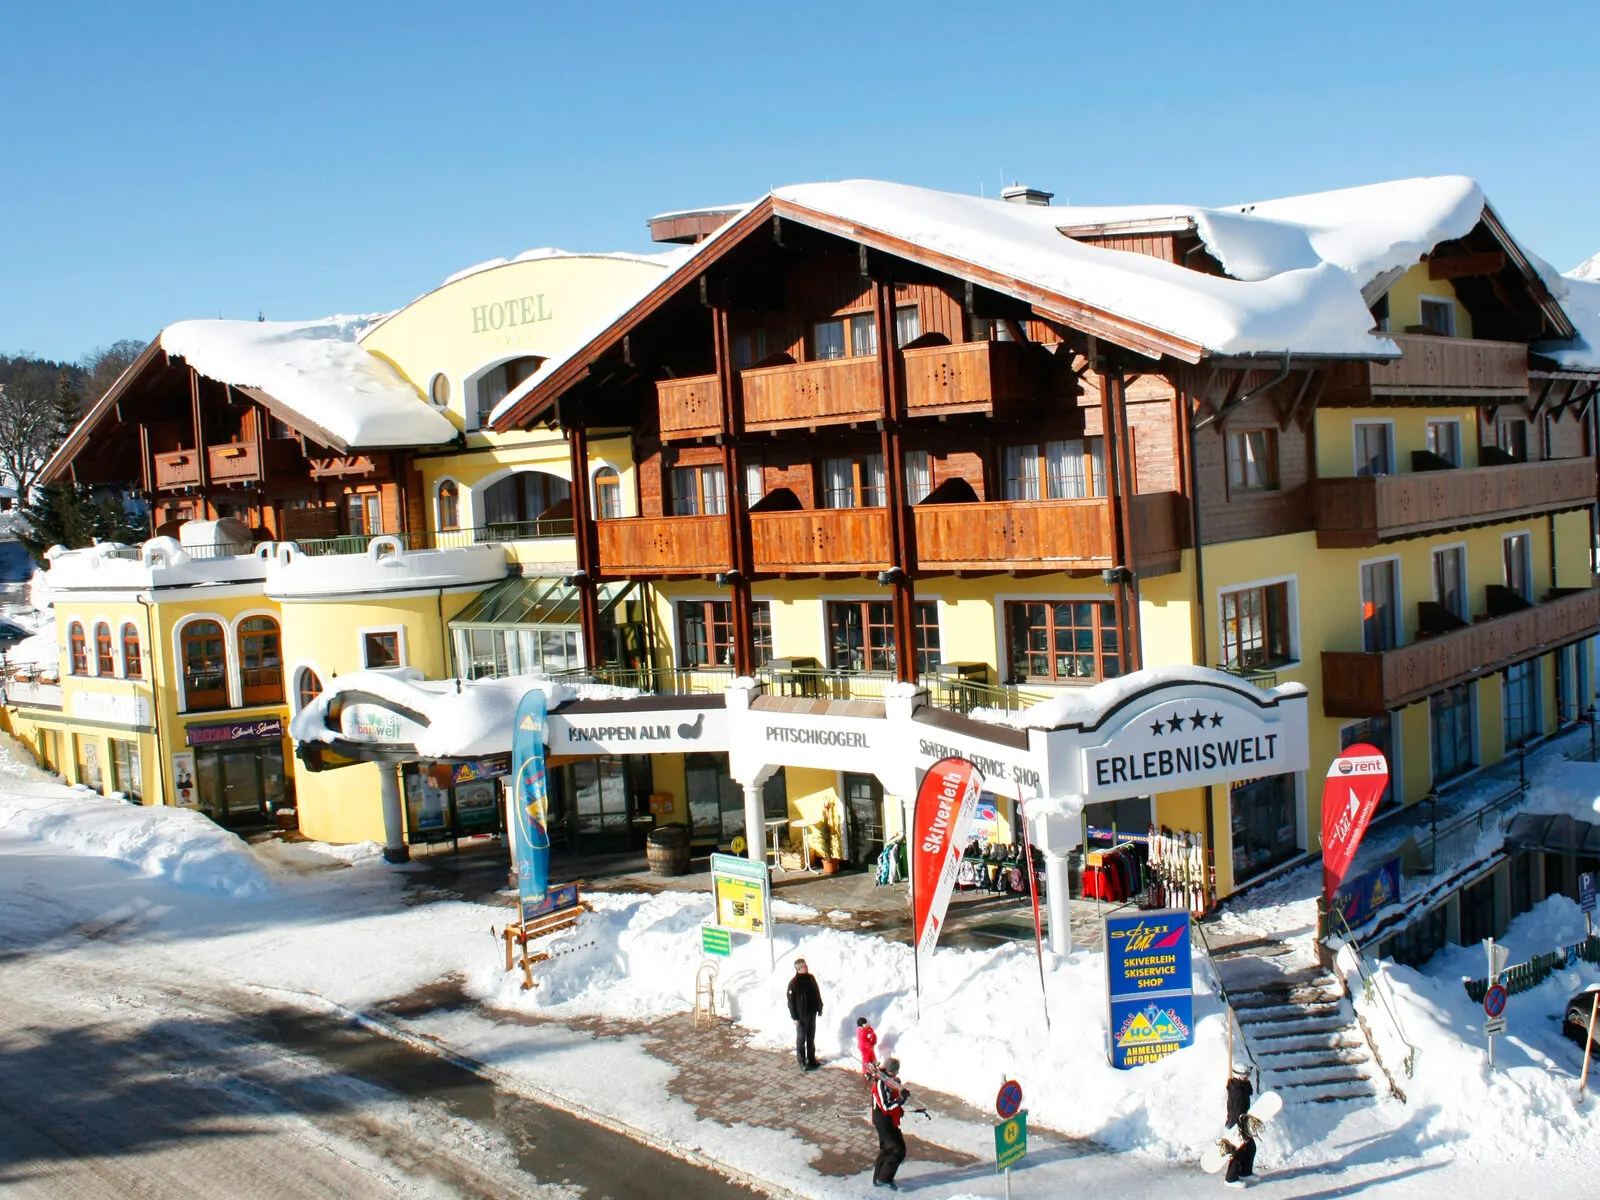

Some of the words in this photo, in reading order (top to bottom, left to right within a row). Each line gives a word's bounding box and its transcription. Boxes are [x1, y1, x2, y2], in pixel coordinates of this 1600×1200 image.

[471, 294, 553, 333] HOTEL
[568, 726, 638, 742] KNAPPEN
[640, 725, 672, 740] ALM
[766, 726, 871, 749] PFITSCHIGOGERL
[1096, 733, 1278, 786] ERLEBNISWELT
[1354, 760, 1382, 773] rent
[1013, 765, 1040, 788] SHOP
[922, 772, 963, 855] Skiverleih
[1582, 874, 1591, 890] P
[1111, 925, 1169, 938] SCHI
[1124, 921, 1156, 953] Lenz
[1124, 955, 1176, 967] SKIVERLEIH
[1124, 966, 1176, 979] SKISERVICE
[1137, 978, 1164, 988] SHOP
[1126, 1043, 1180, 1056] ANMELDUNG
[1007, 1125, 1016, 1139] H
